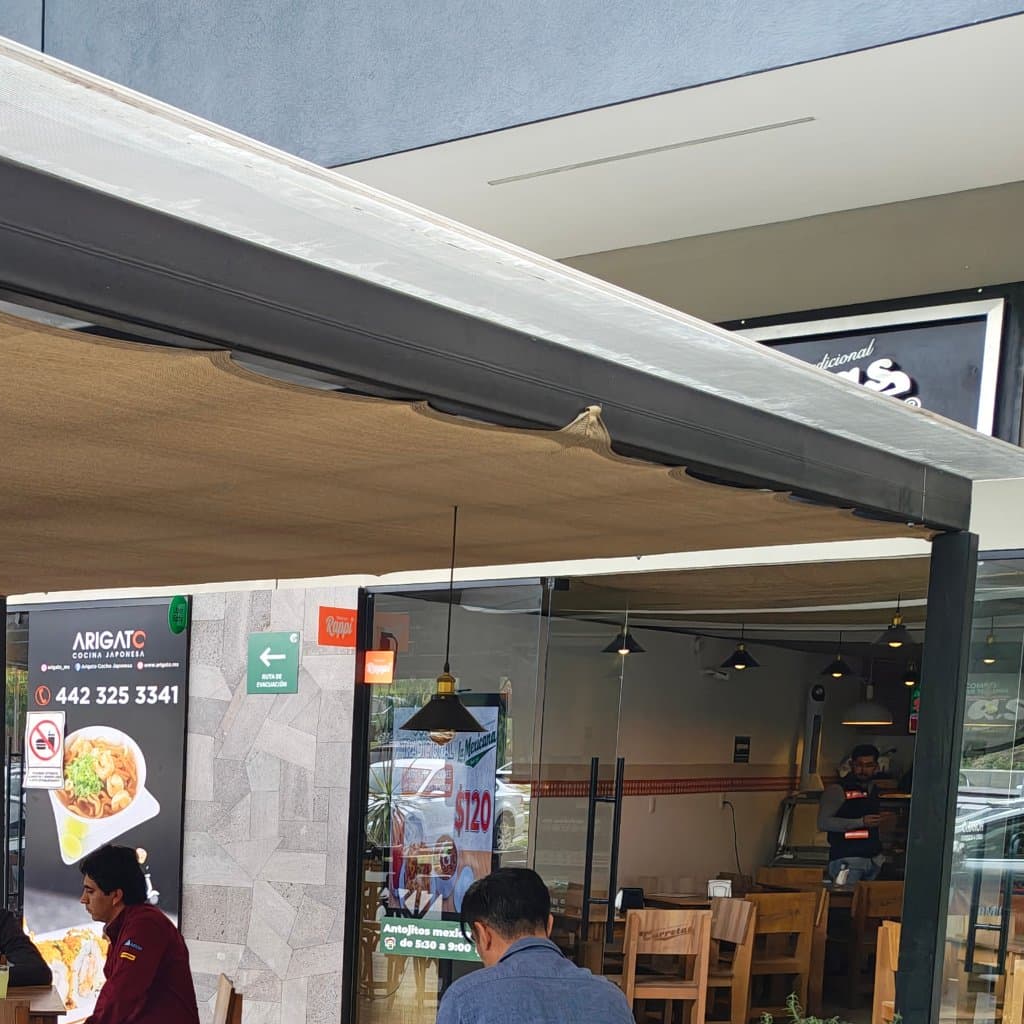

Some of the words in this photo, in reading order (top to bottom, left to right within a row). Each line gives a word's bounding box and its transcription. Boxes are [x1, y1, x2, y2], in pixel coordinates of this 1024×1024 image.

[814, 338, 875, 369] dicional
[326, 616, 354, 640] Rappi
[72, 630, 146, 650] ARIGATO
[72, 651, 102, 659] COCINA
[105, 650, 145, 658] JAPONESA
[56, 686, 90, 704] 442
[96, 686, 129, 704] 325
[135, 685, 179, 704] 3341
[454, 784, 492, 837] $120
[383, 924, 430, 936] Antojitos
[400, 938, 413, 948] de
[415, 939, 437, 950] 5:30
[448, 942, 471, 952] 9:00
